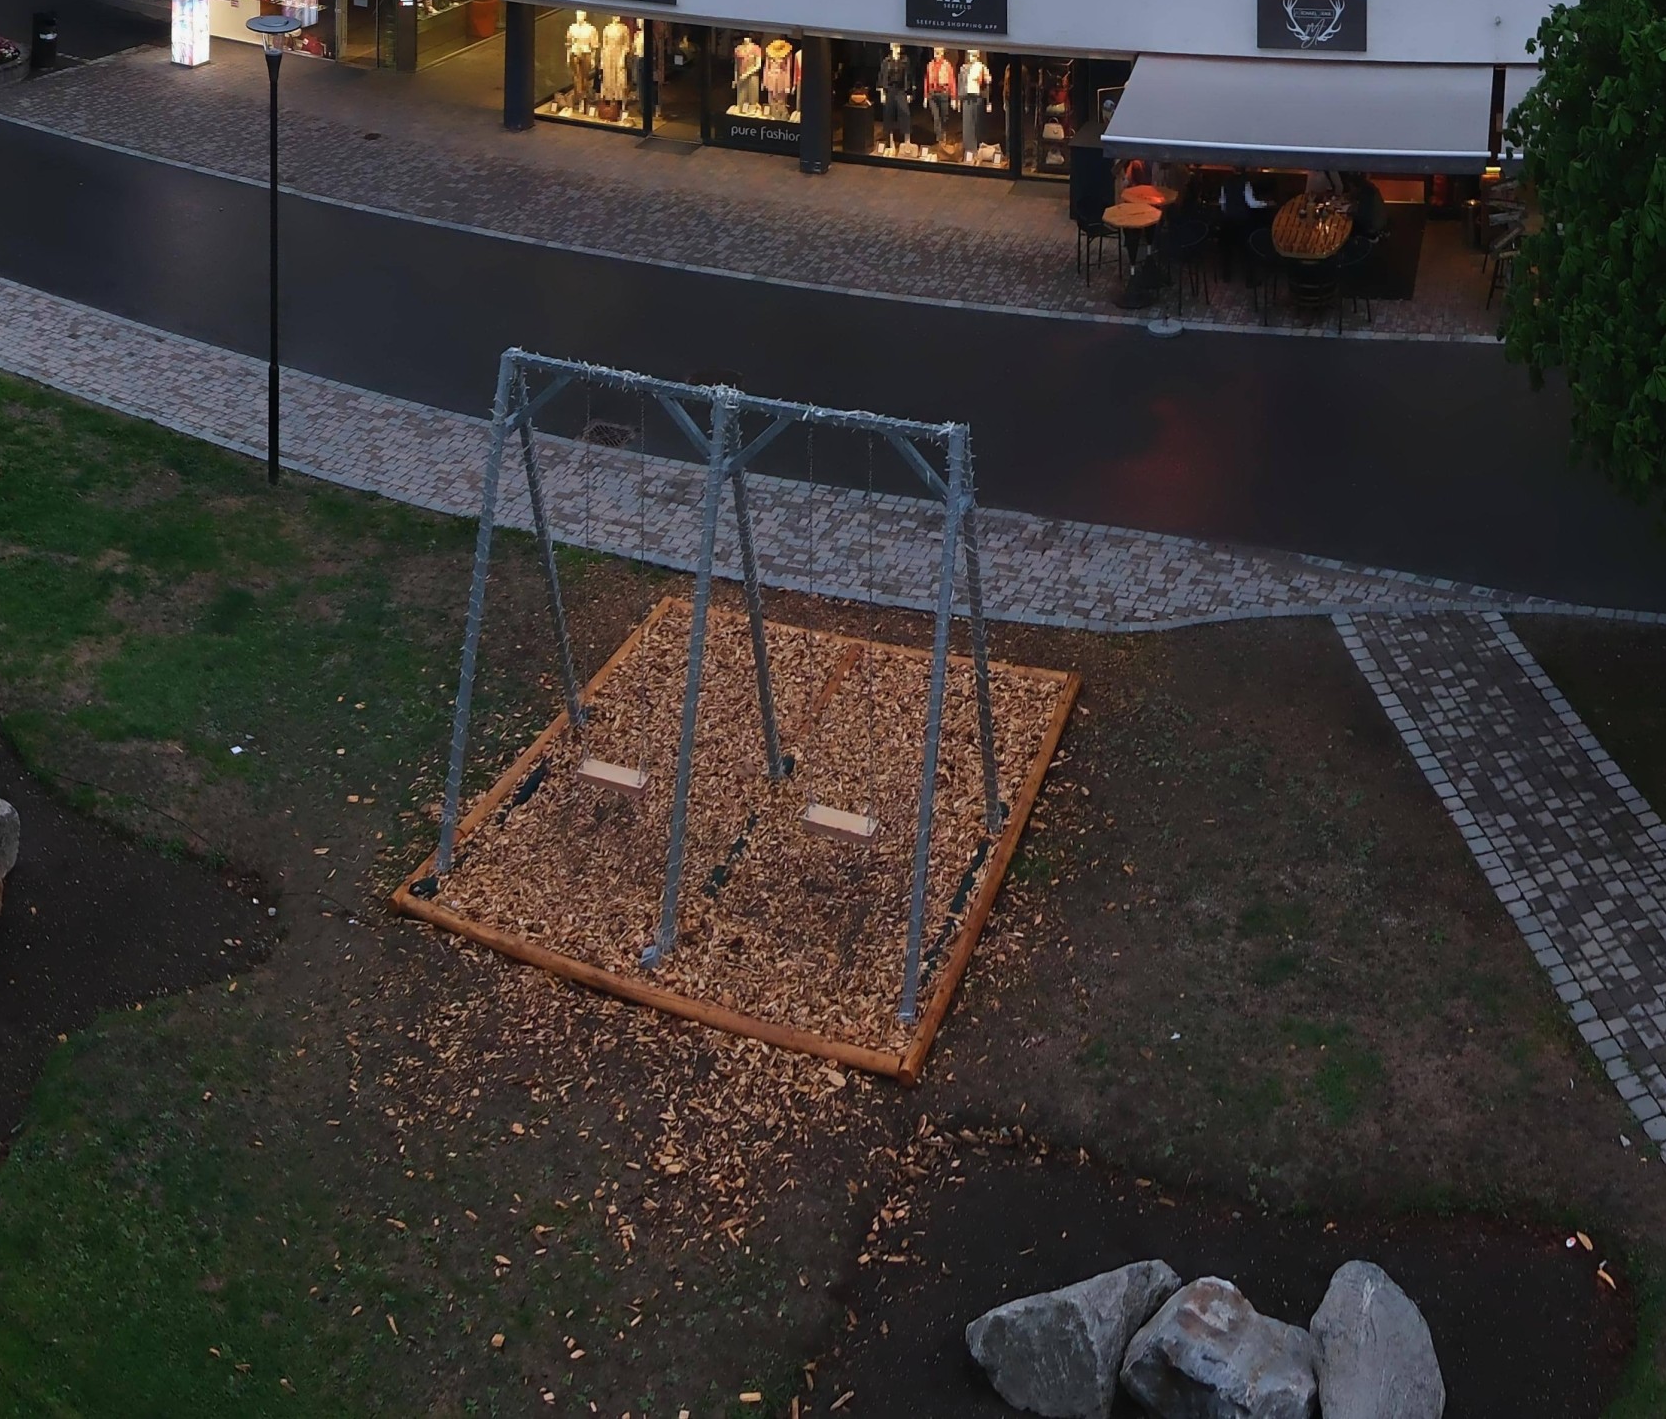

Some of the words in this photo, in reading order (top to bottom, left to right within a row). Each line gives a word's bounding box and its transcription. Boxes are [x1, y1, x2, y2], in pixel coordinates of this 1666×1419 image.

[943, 2, 972, 10] SEEFELD
[916, 19, 945, 27] SEEFELD
[947, 21, 983, 29] SHOPPING
[731, 125, 757, 137] pure
